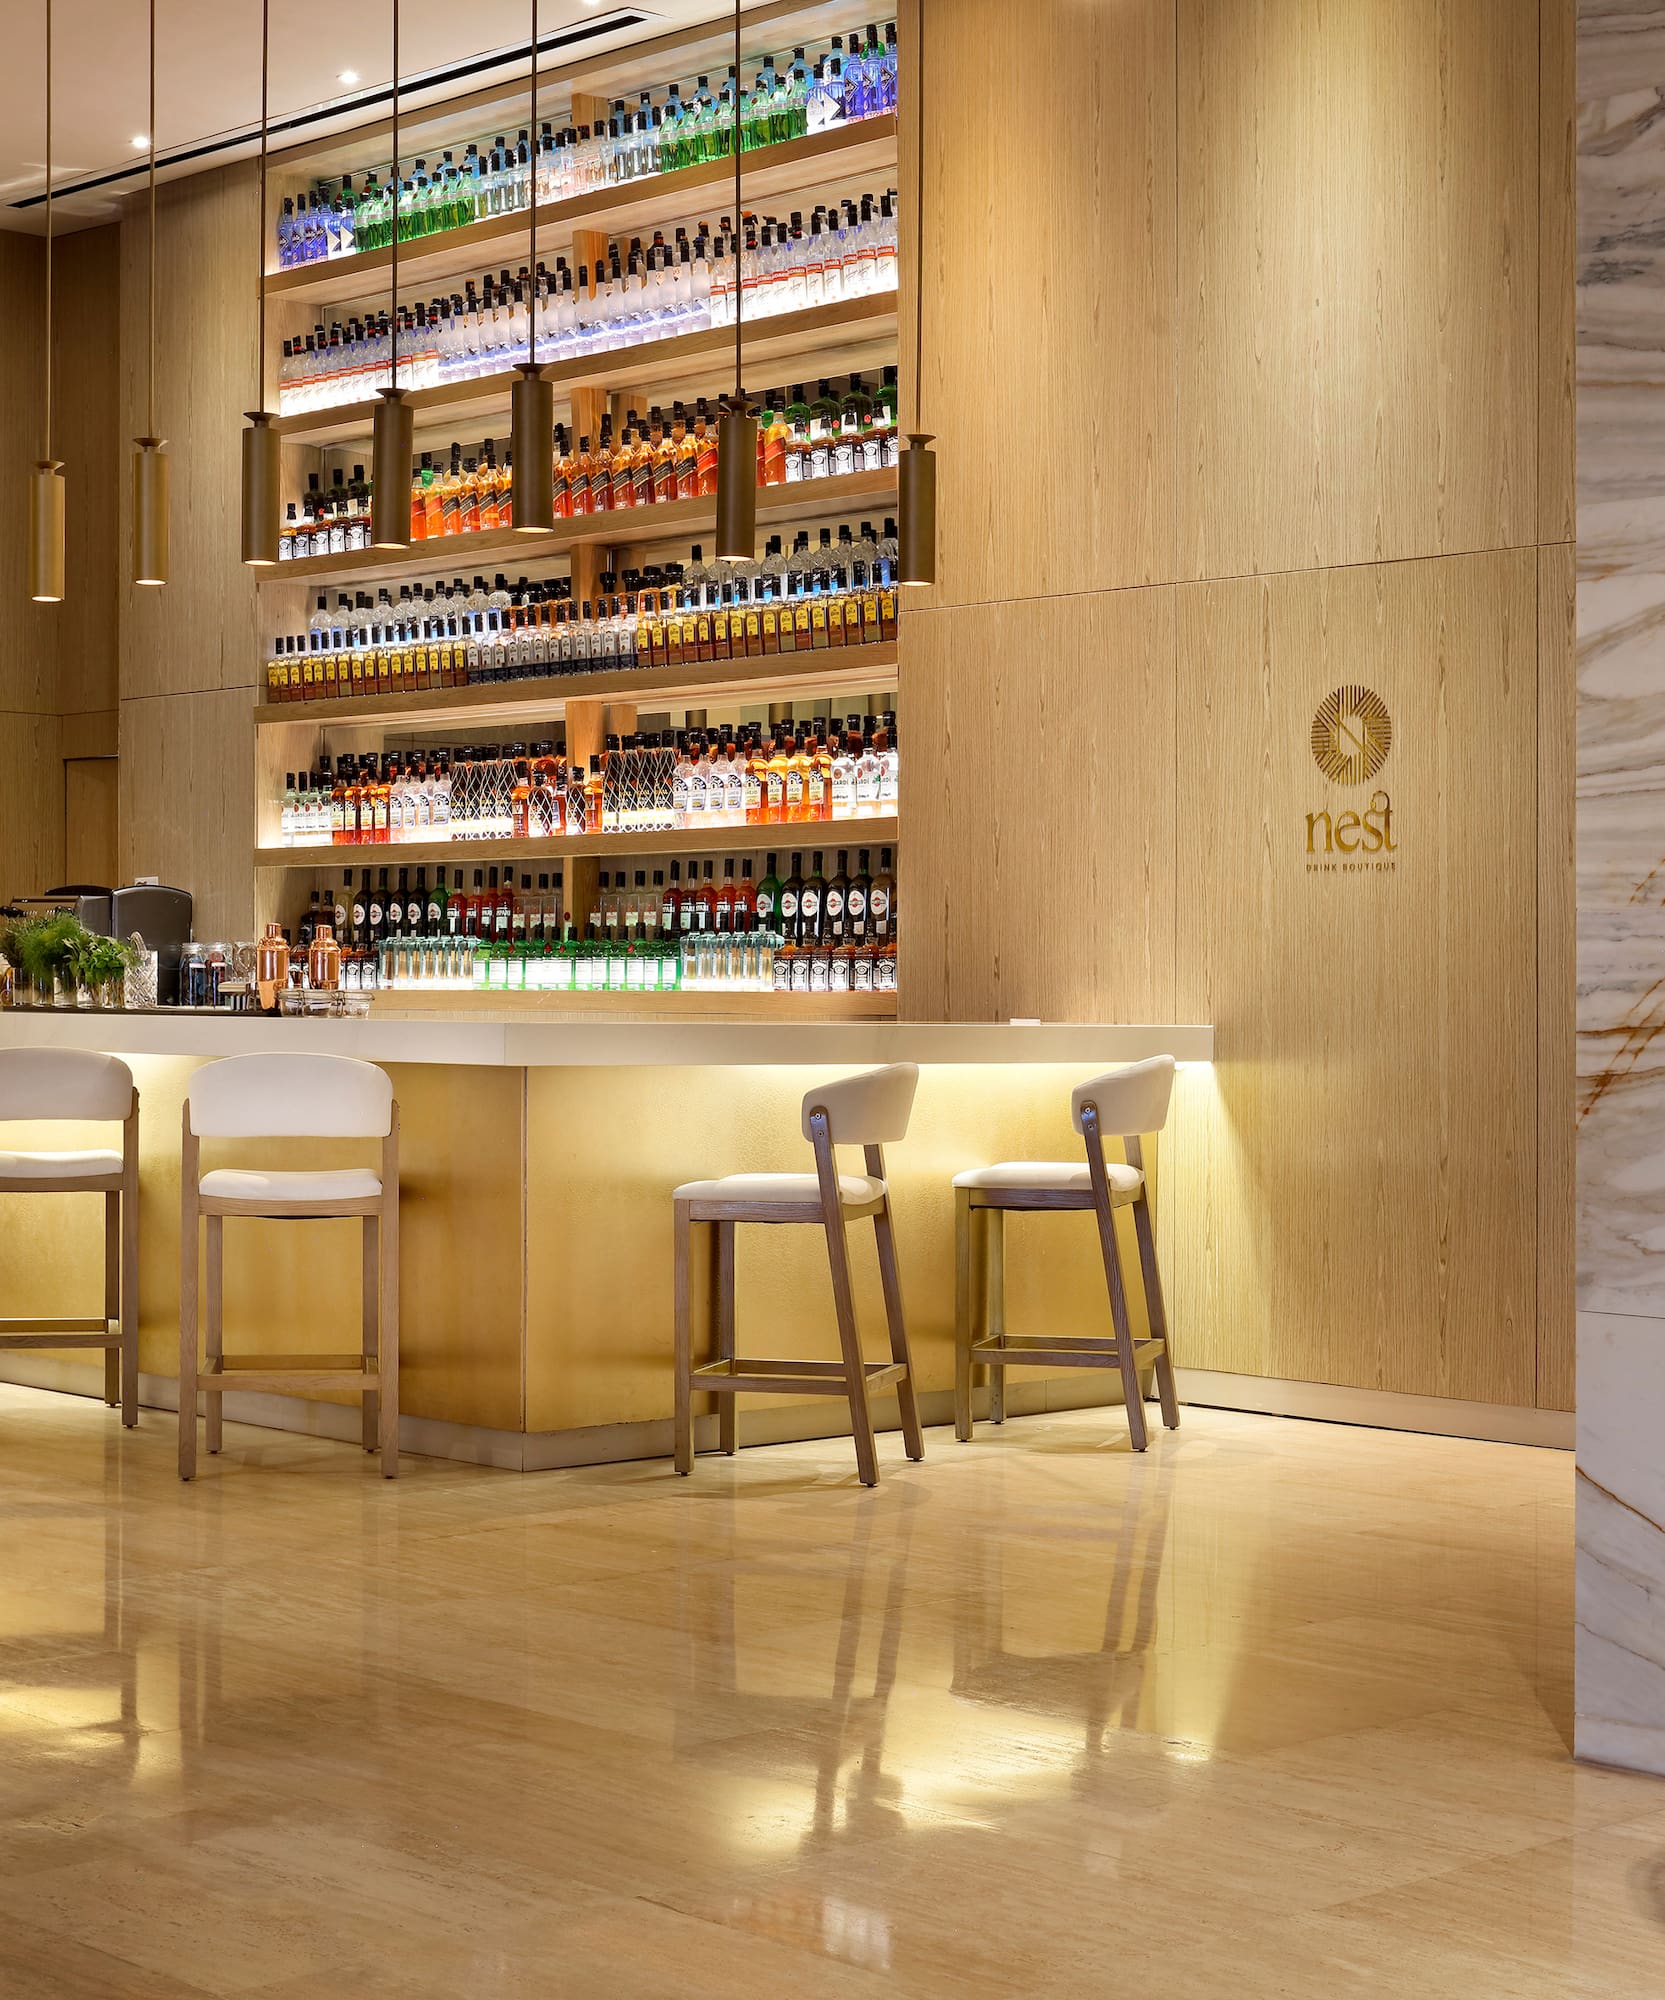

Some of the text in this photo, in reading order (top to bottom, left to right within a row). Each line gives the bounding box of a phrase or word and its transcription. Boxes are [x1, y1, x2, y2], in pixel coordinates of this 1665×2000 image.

[1305, 790, 1398, 852] nest
[1305, 861, 1396, 873] DRINK BOUTIQUE
